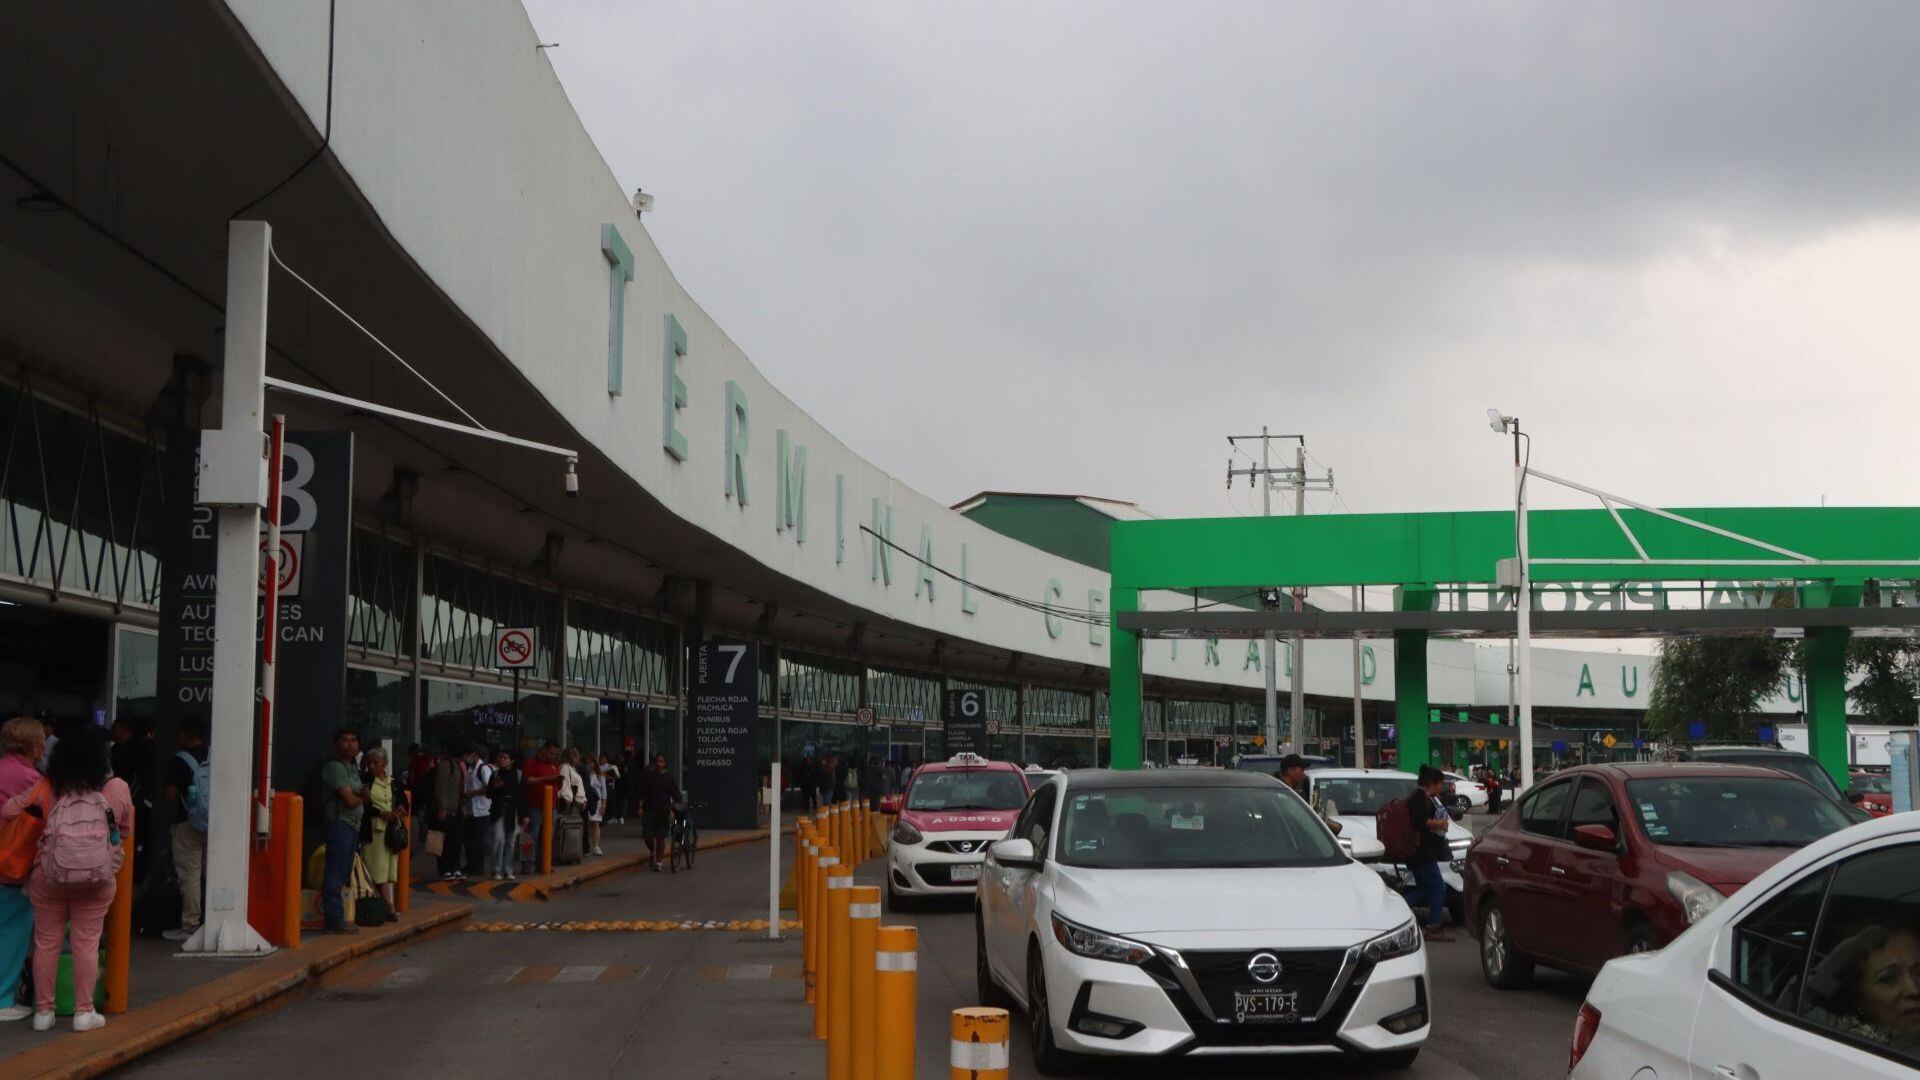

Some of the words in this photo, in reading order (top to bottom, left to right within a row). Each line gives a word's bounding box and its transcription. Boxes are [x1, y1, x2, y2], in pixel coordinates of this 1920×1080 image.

[601, 223, 977, 614] TERMINAL
[258, 442, 317, 532] 8
[698, 645, 708, 684] PUERTA
[718, 645, 746, 684] 7
[697, 704, 734, 712] PACHUCA
[961, 692, 979, 717] 6
[1592, 731, 1601, 744] 4
[697, 759, 732, 767] PEGASSO
[1235, 996, 1298, 1012] PVS-179-E
